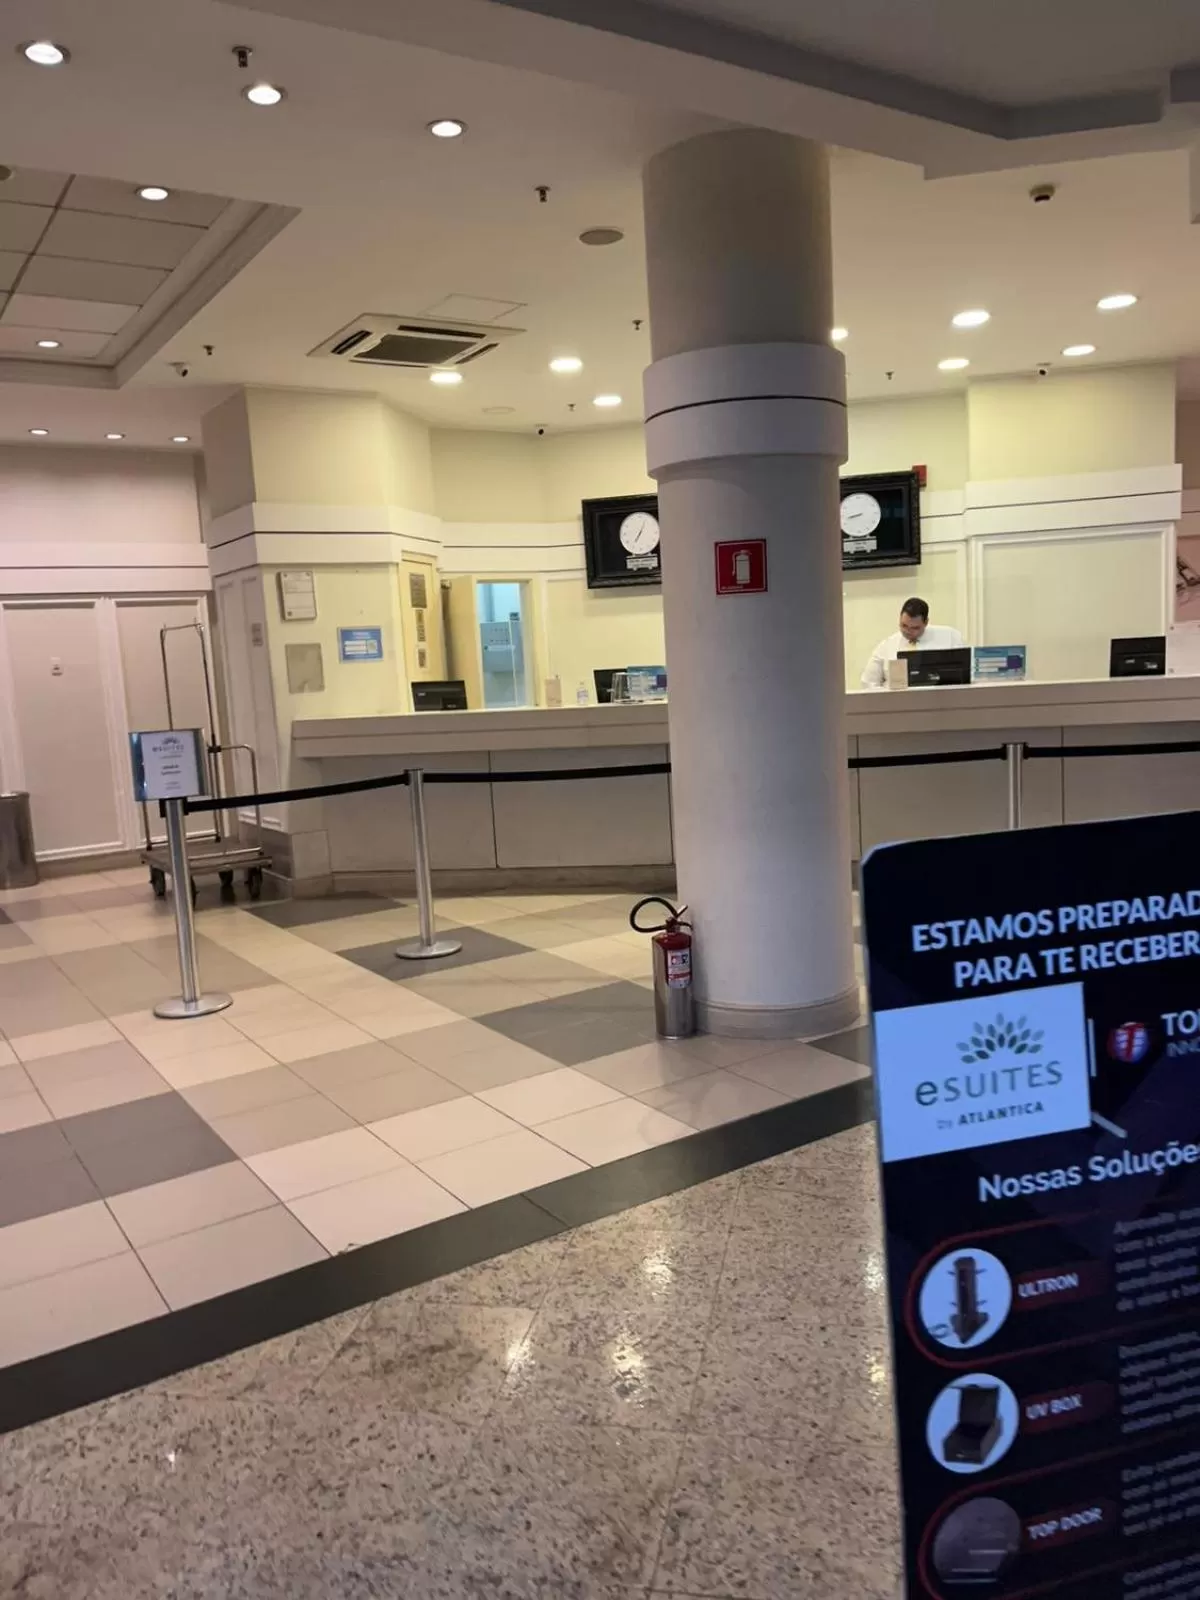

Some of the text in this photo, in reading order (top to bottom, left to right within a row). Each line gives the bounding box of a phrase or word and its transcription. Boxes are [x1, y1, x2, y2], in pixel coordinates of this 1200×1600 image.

[912, 890, 1200, 951] ESTAMOS PREPARAD
[954, 930, 1200, 988] PARA TE RECEBER
[1160, 1008, 1200, 1036] TO
[915, 1061, 1063, 1106] eSUITES
[958, 1101, 1044, 1125] ATLANTICA
[979, 1141, 1200, 1202] Nossas Soluçõe
[1018, 1272, 1079, 1298] ULTRON
[1027, 1507, 1103, 1540] TOP DOOR
